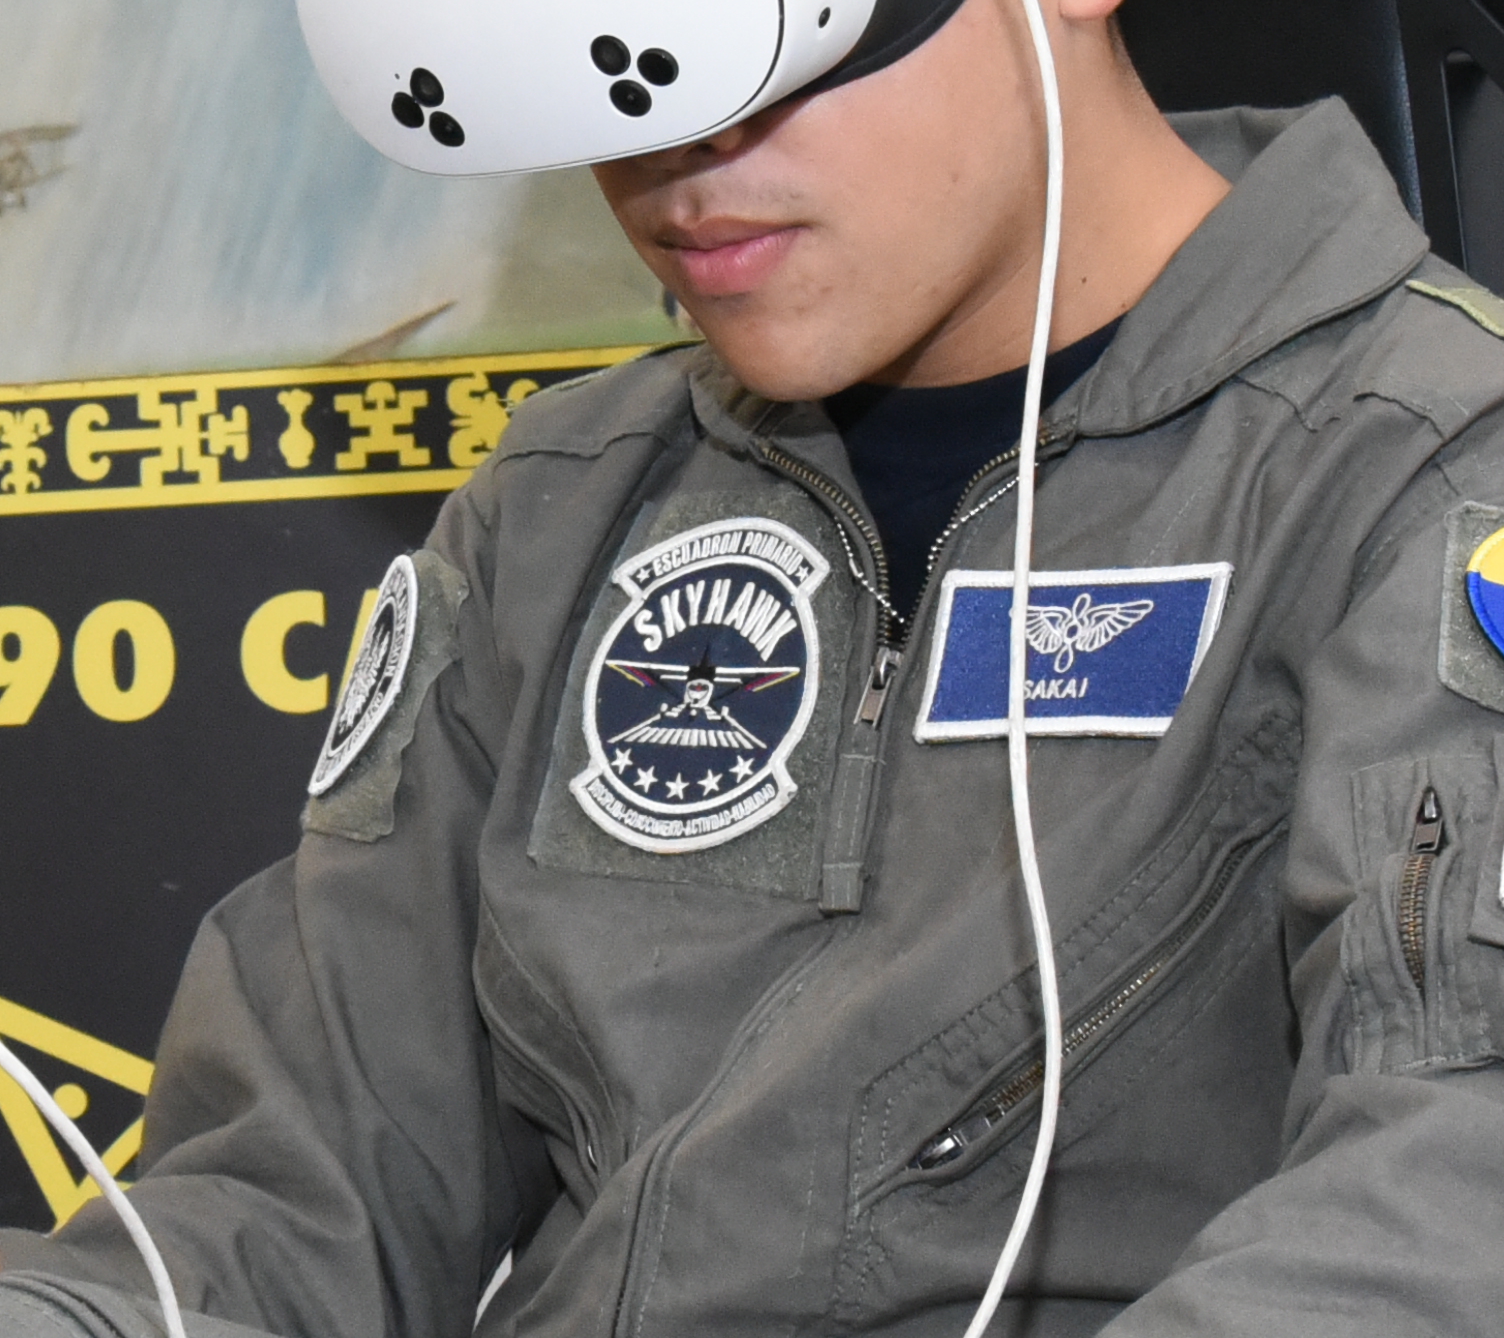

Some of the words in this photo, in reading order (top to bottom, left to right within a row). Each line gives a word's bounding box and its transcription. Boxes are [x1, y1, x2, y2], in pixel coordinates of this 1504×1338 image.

[651, 529, 744, 578] ESCUADRON
[740, 529, 805, 577] PRIMARIO
[633, 577, 799, 663] SKYHAWK
